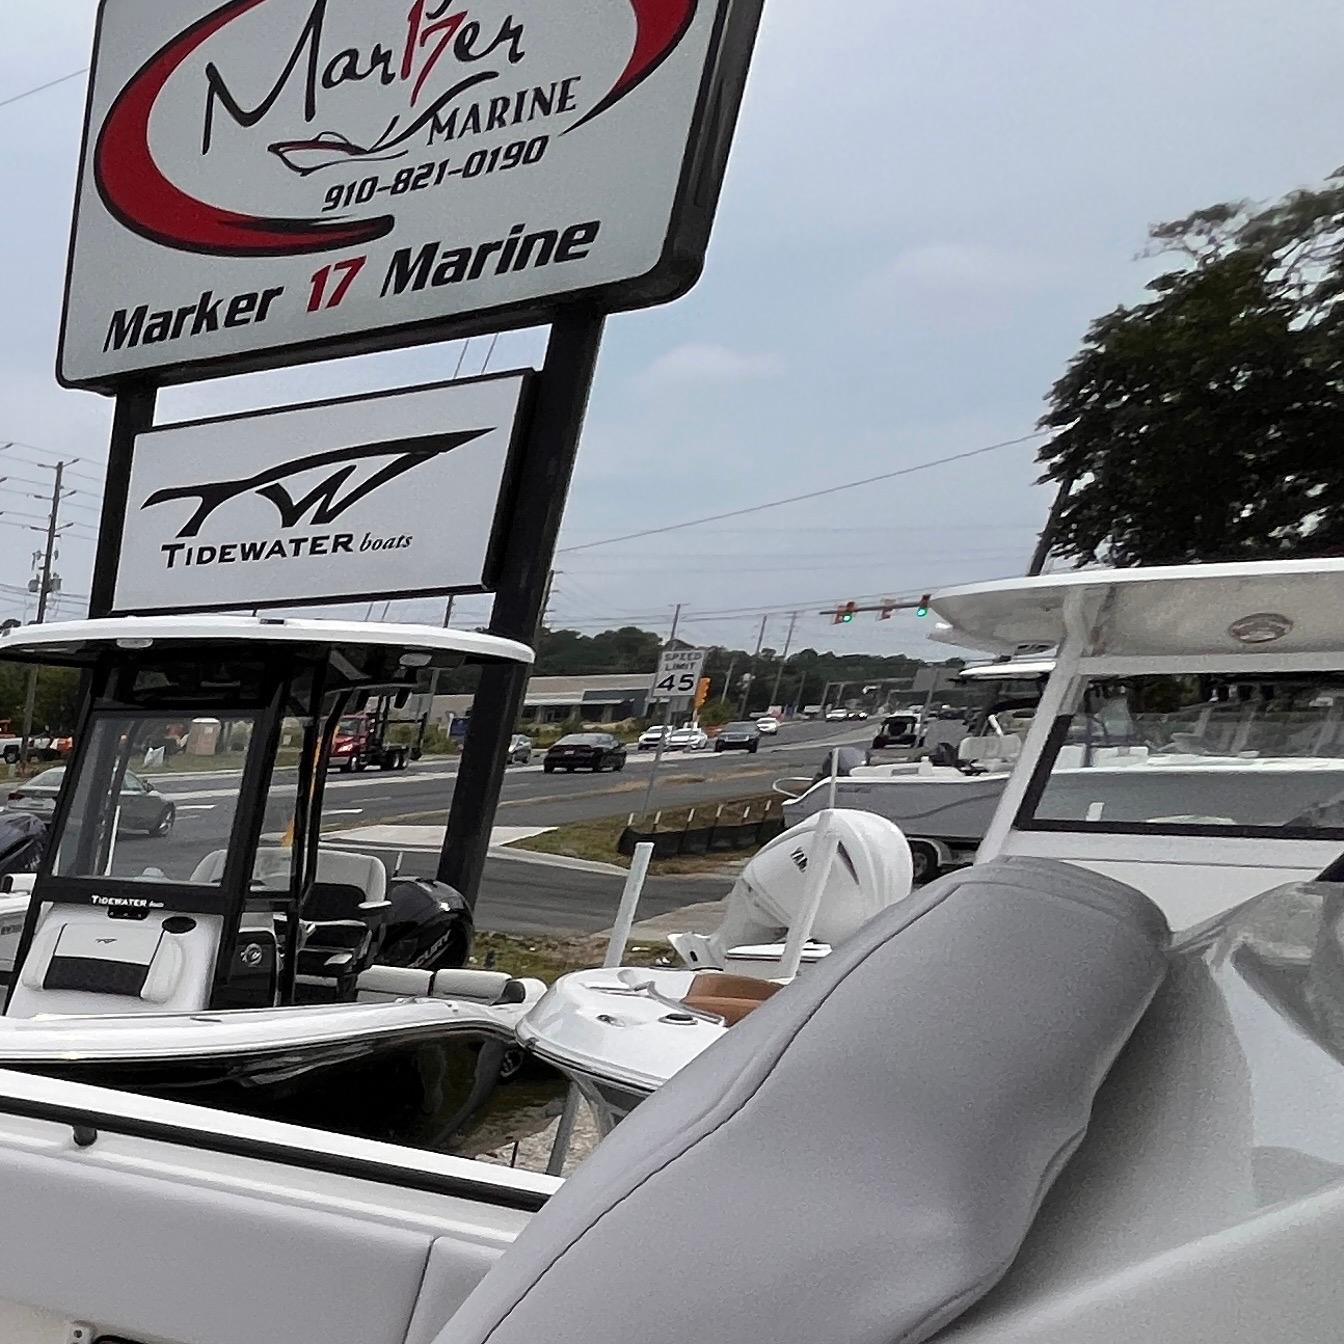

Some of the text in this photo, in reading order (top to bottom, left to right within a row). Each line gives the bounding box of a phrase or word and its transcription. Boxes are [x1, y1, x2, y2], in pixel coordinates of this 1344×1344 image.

[425, 75, 582, 146] MARINE
[321, 135, 550, 212] 910-821-0190
[102, 219, 601, 354] Marker 17 Marine
[161, 532, 413, 569] TIDEWATER boats
[664, 651, 703, 661] SPEED
[664, 662, 697, 672] LIMIT
[655, 673, 695, 692] 45
